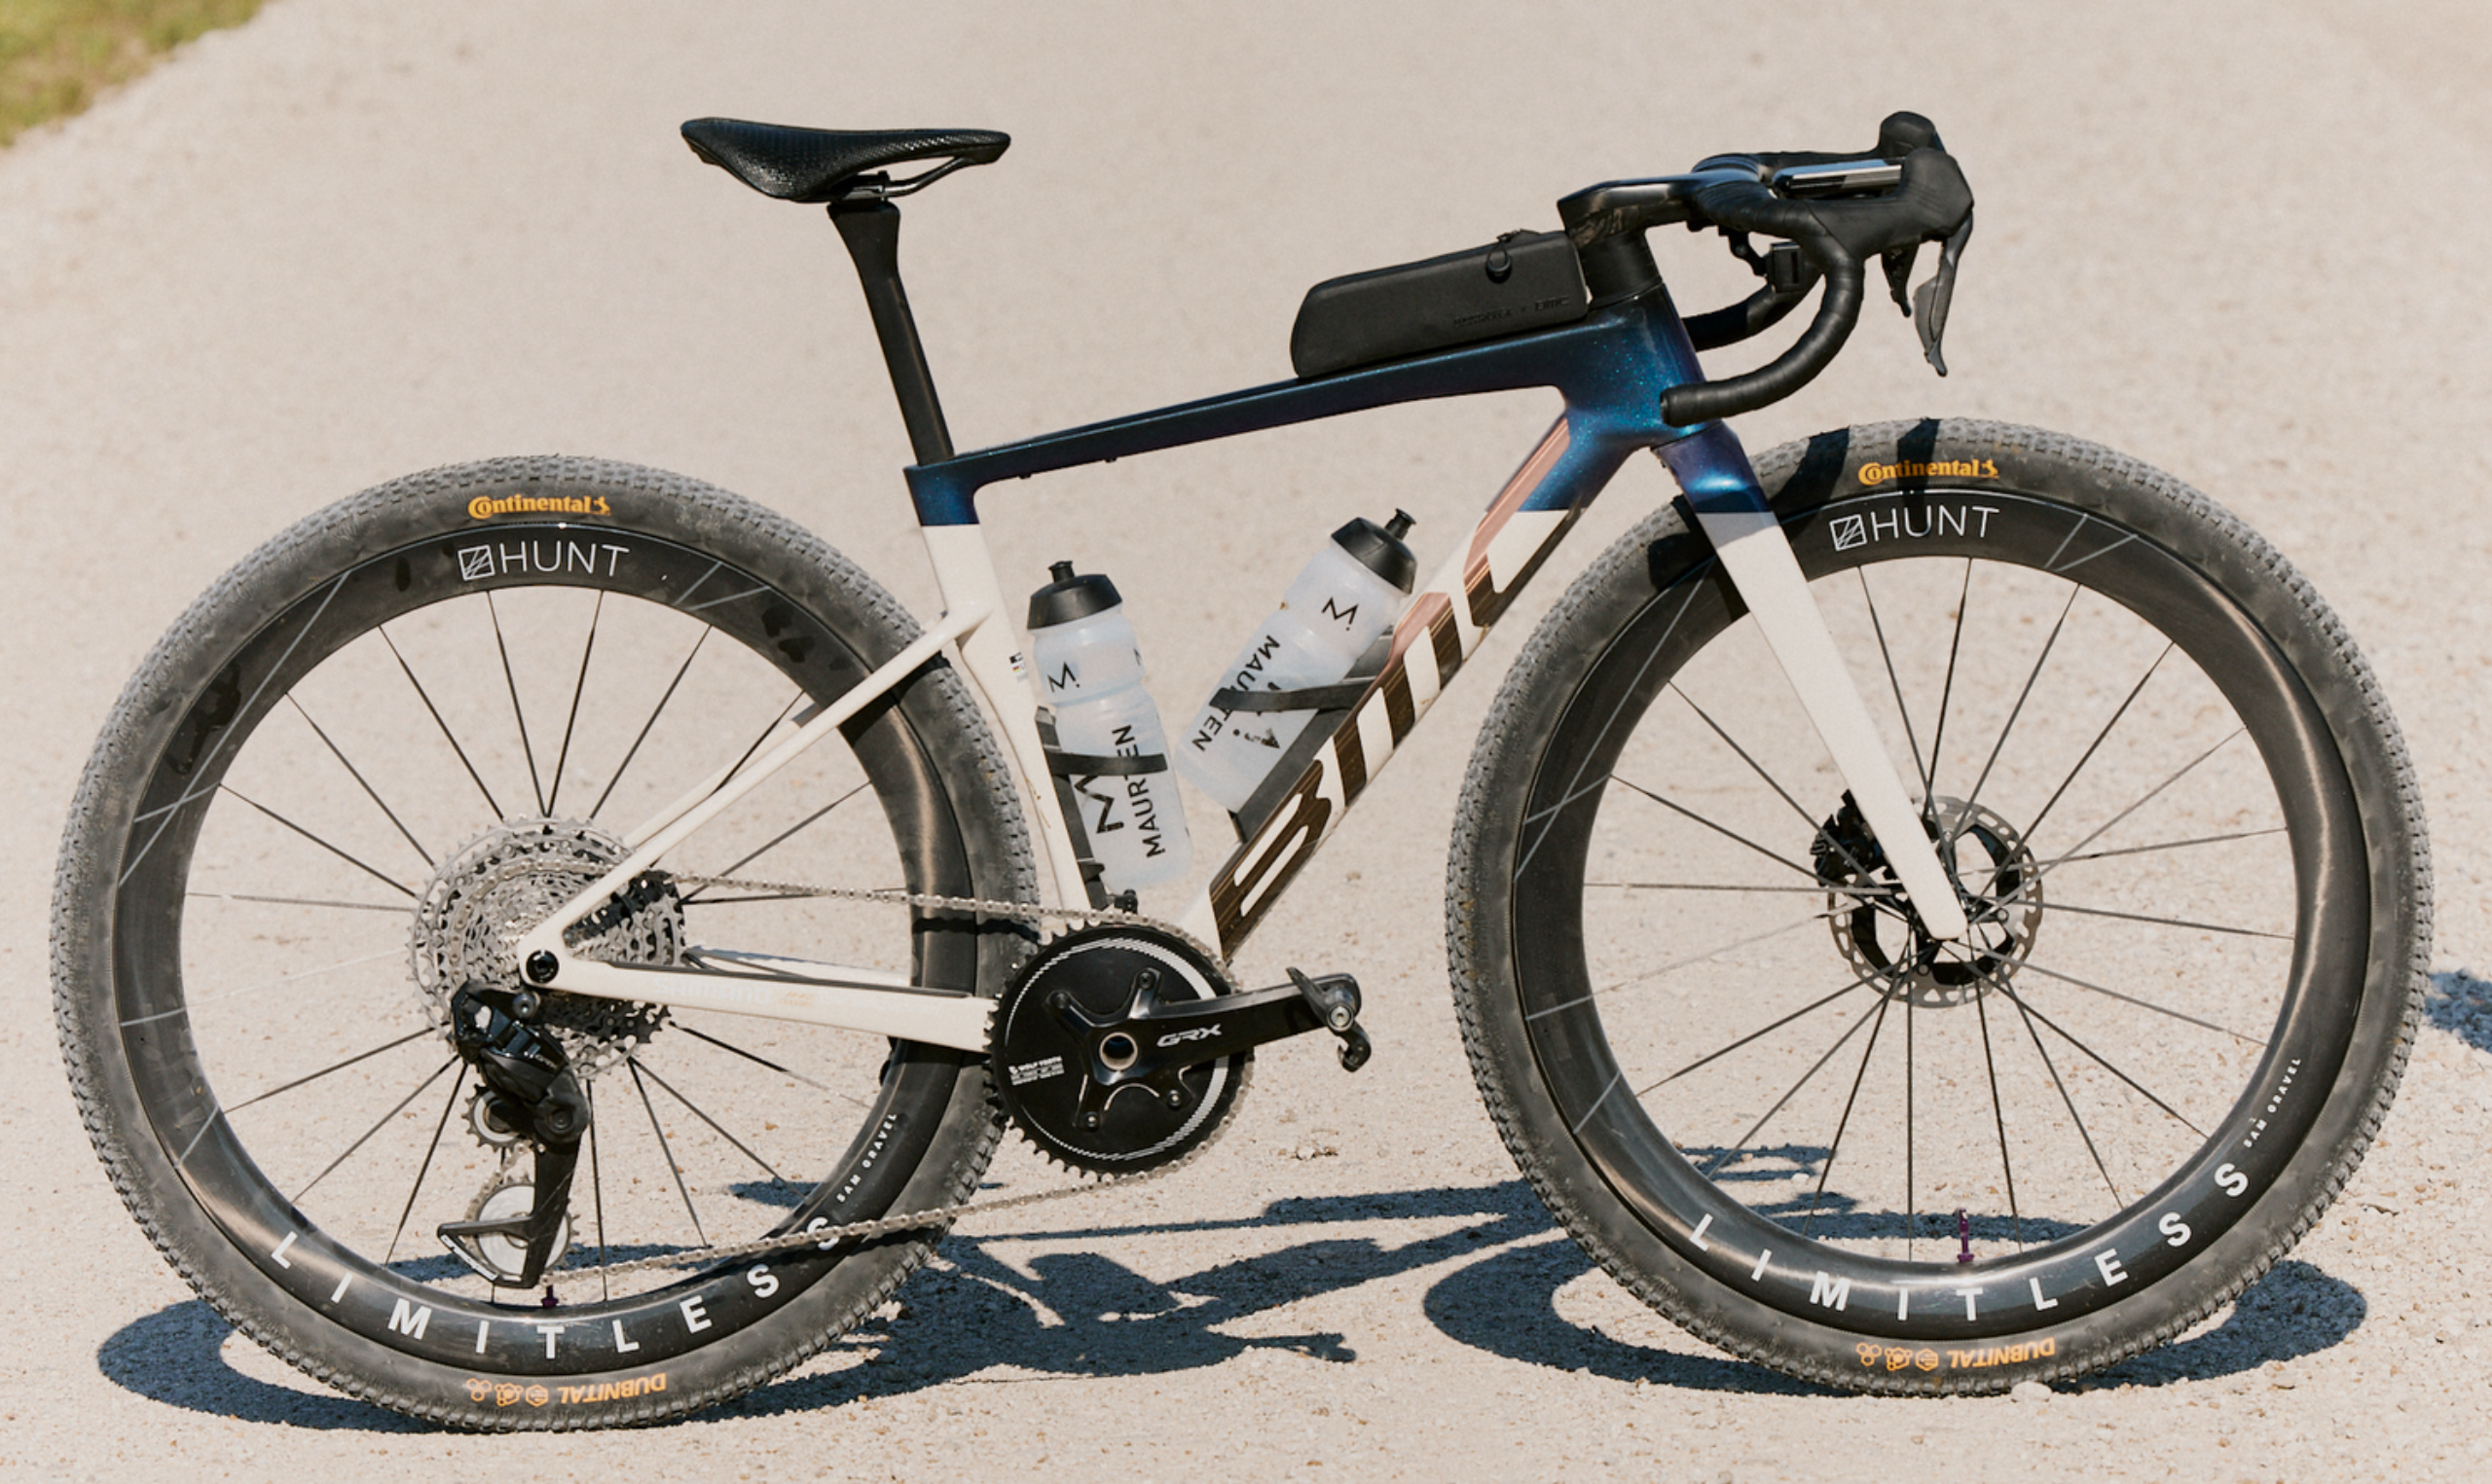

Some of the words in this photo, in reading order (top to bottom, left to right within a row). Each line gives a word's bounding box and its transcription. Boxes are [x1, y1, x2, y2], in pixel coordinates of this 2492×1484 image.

[1857, 458, 1980, 486] Continental
[467, 493, 592, 520] Continental
[1870, 505, 1999, 541] HUNT
[499, 540, 630, 577] HUNT
[1191, 634, 1280, 752] MAUTEN
[1112, 724, 1166, 858] MAUREN
[653, 976, 771, 1006] SHIMANO
[1156, 1023, 1223, 1048] GRX
[2267, 1059, 2301, 1113] GRAVEL
[861, 1113, 898, 1169] GRAVEL
[1689, 1162, 2250, 1322] LIMITLESS
[271, 1216, 840, 1359] LIMITLESS
[1947, 1336, 2056, 1369] DUBNITAL
[557, 1372, 667, 1404] DUBNITAL
